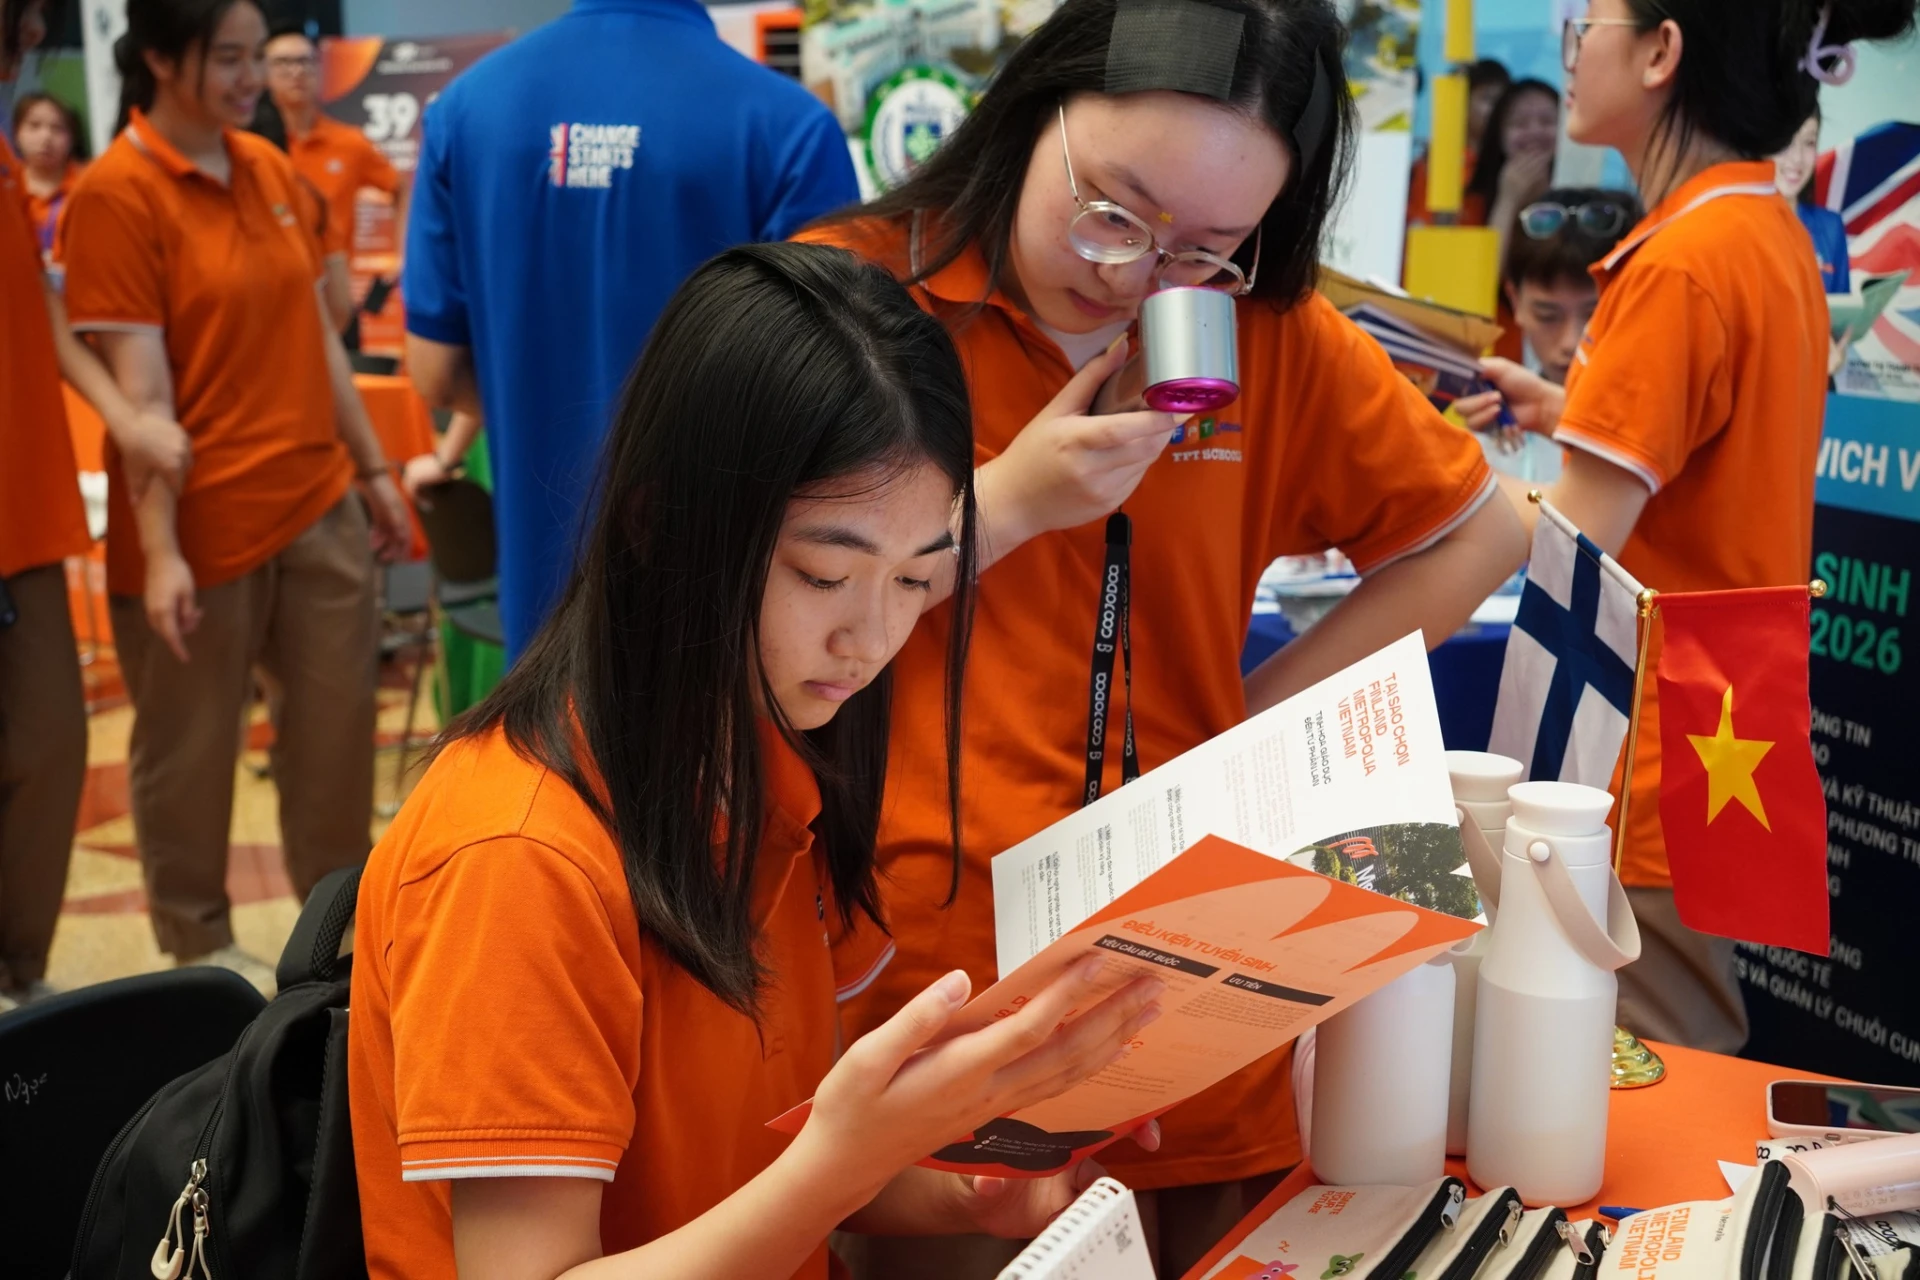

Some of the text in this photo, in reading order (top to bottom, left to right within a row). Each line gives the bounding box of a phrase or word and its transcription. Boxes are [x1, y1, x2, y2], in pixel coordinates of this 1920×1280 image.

[361, 91, 419, 142] 39
[569, 122, 641, 147] CHANGE
[568, 144, 635, 169] STARTS
[566, 165, 613, 188] HERE
[1201, 447, 1243, 463] SCHOOL
[1815, 551, 1911, 617] SINH
[1809, 607, 1903, 676] 2026
[1368, 680, 1388, 737] FINLAND
[1383, 672, 1410, 767] TẠI SAO CHỌN
[1317, 728, 1327, 747] HOA
[1338, 696, 1357, 759] VIETNAM
[1353, 688, 1377, 777] METROPOLIA
[1844, 719, 1871, 748] TIN
[1311, 769, 1320, 787] LAN
[1828, 810, 1898, 855] PHƯƠNG
[1101, 937, 1182, 967] YÊU CẦU BẮT BUỘC
[1120, 919, 1278, 973] ĐIỀU KIỆN TUYỂN SINH
[1243, 982, 1263, 991] TIÊN
[1307, 1190, 1336, 1214] FUTURE
[1322, 1191, 1346, 1209] YOUR
[1328, 1191, 1356, 1215] IGNITE
[1618, 1214, 1651, 1270] VIETNAM
[1637, 1211, 1671, 1280] METROPOLI
[1662, 1207, 1691, 1261] FINLAND
